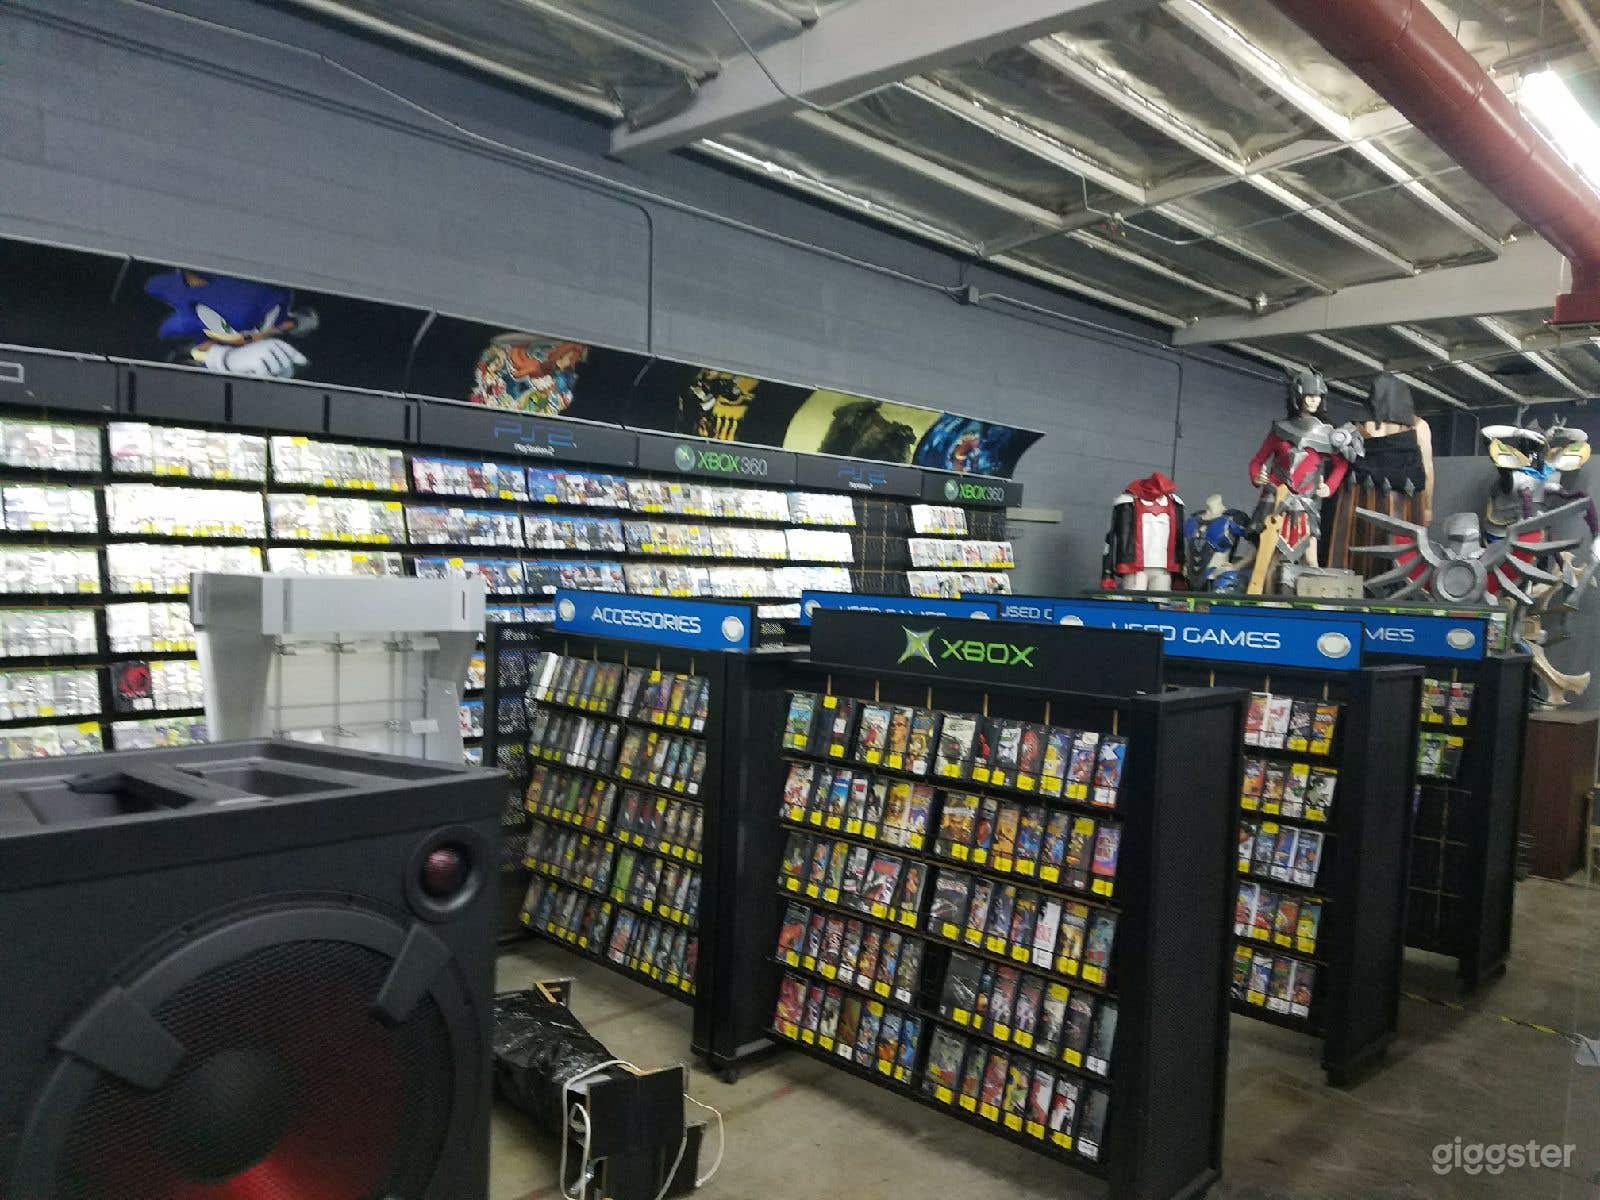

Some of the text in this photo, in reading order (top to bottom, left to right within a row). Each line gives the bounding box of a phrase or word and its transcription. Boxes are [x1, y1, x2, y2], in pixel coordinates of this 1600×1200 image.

[697, 450, 768, 476] XBOX 360
[591, 606, 701, 634] ACCESSORIES
[1182, 627, 1281, 650] GAMES
[940, 638, 1035, 668] XBOX
